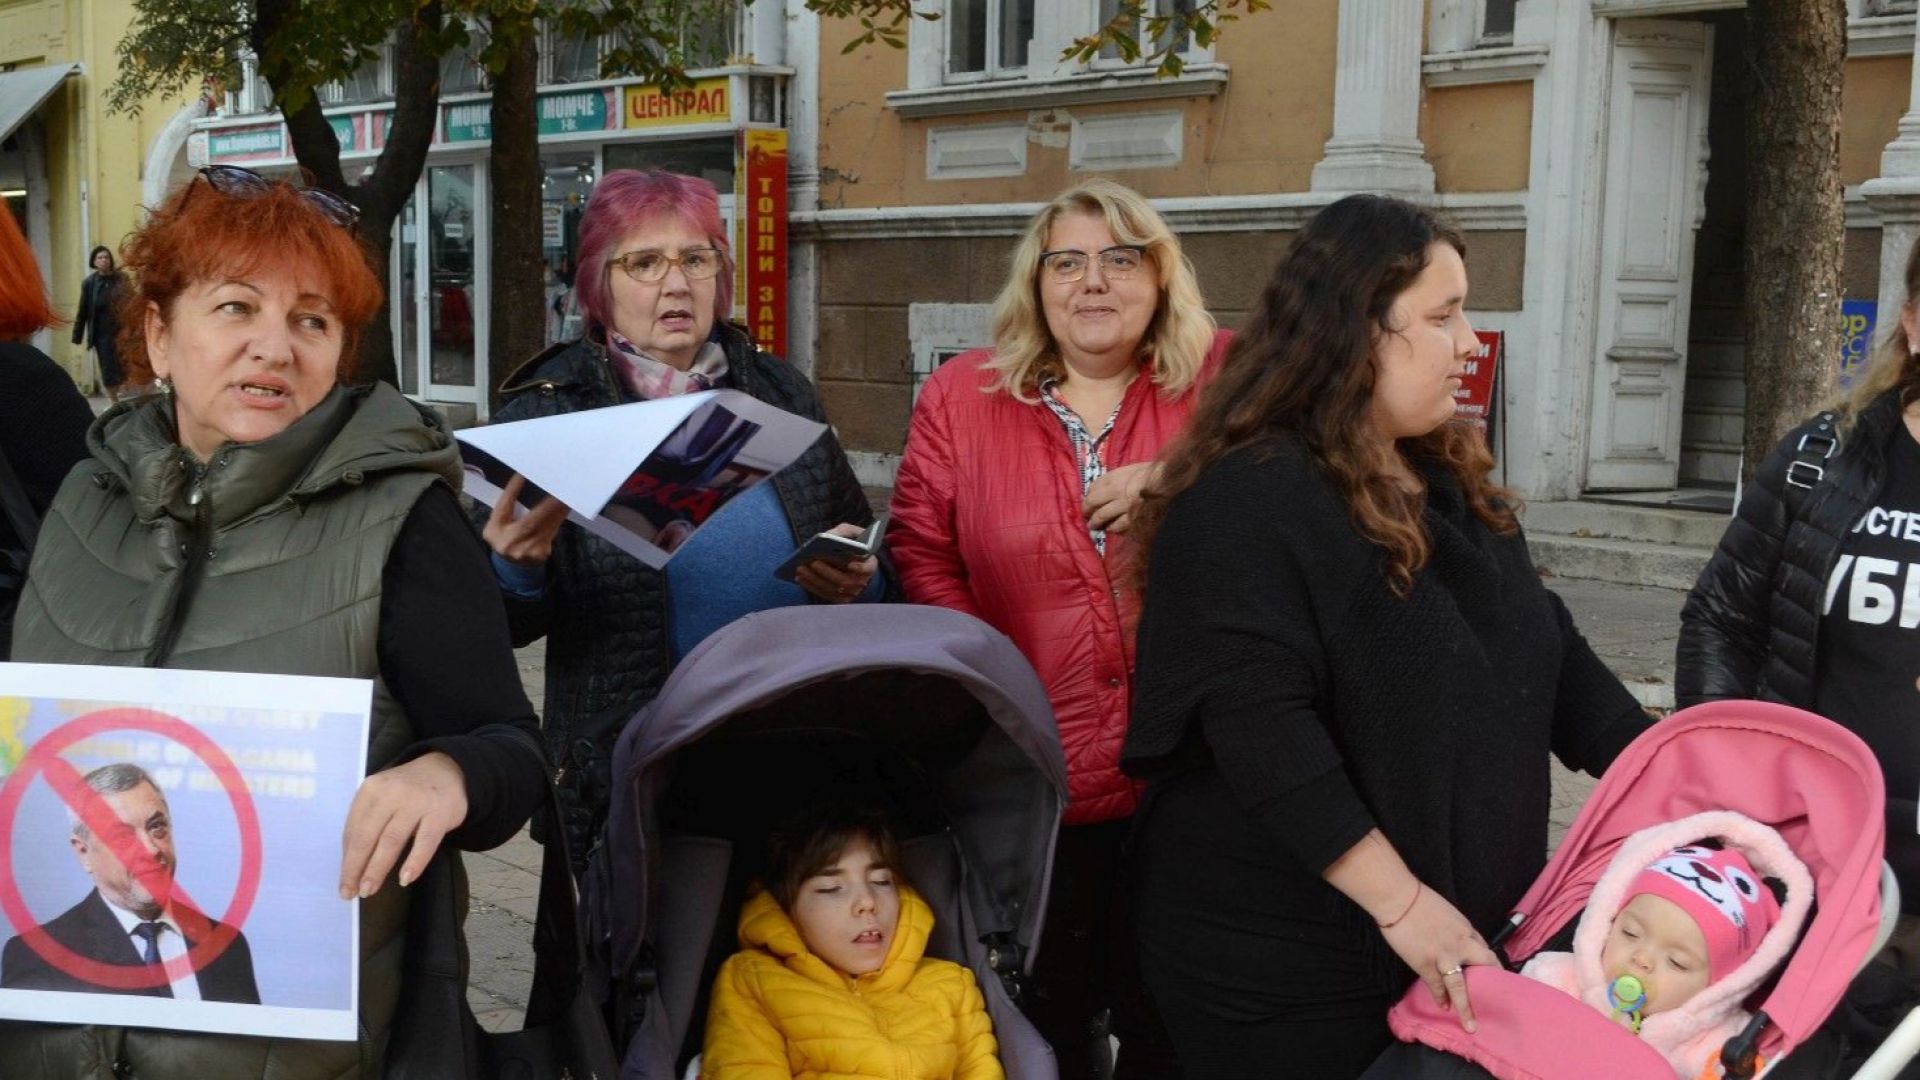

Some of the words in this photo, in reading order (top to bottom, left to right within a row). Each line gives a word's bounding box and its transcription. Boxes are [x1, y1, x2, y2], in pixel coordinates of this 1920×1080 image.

[451, 103, 491, 127] МОМИ
[543, 94, 595, 119] МОМЧЕ
[632, 88, 725, 119] ЦЕНТРАЛ
[758, 177, 775, 272] ТОПЛИ
